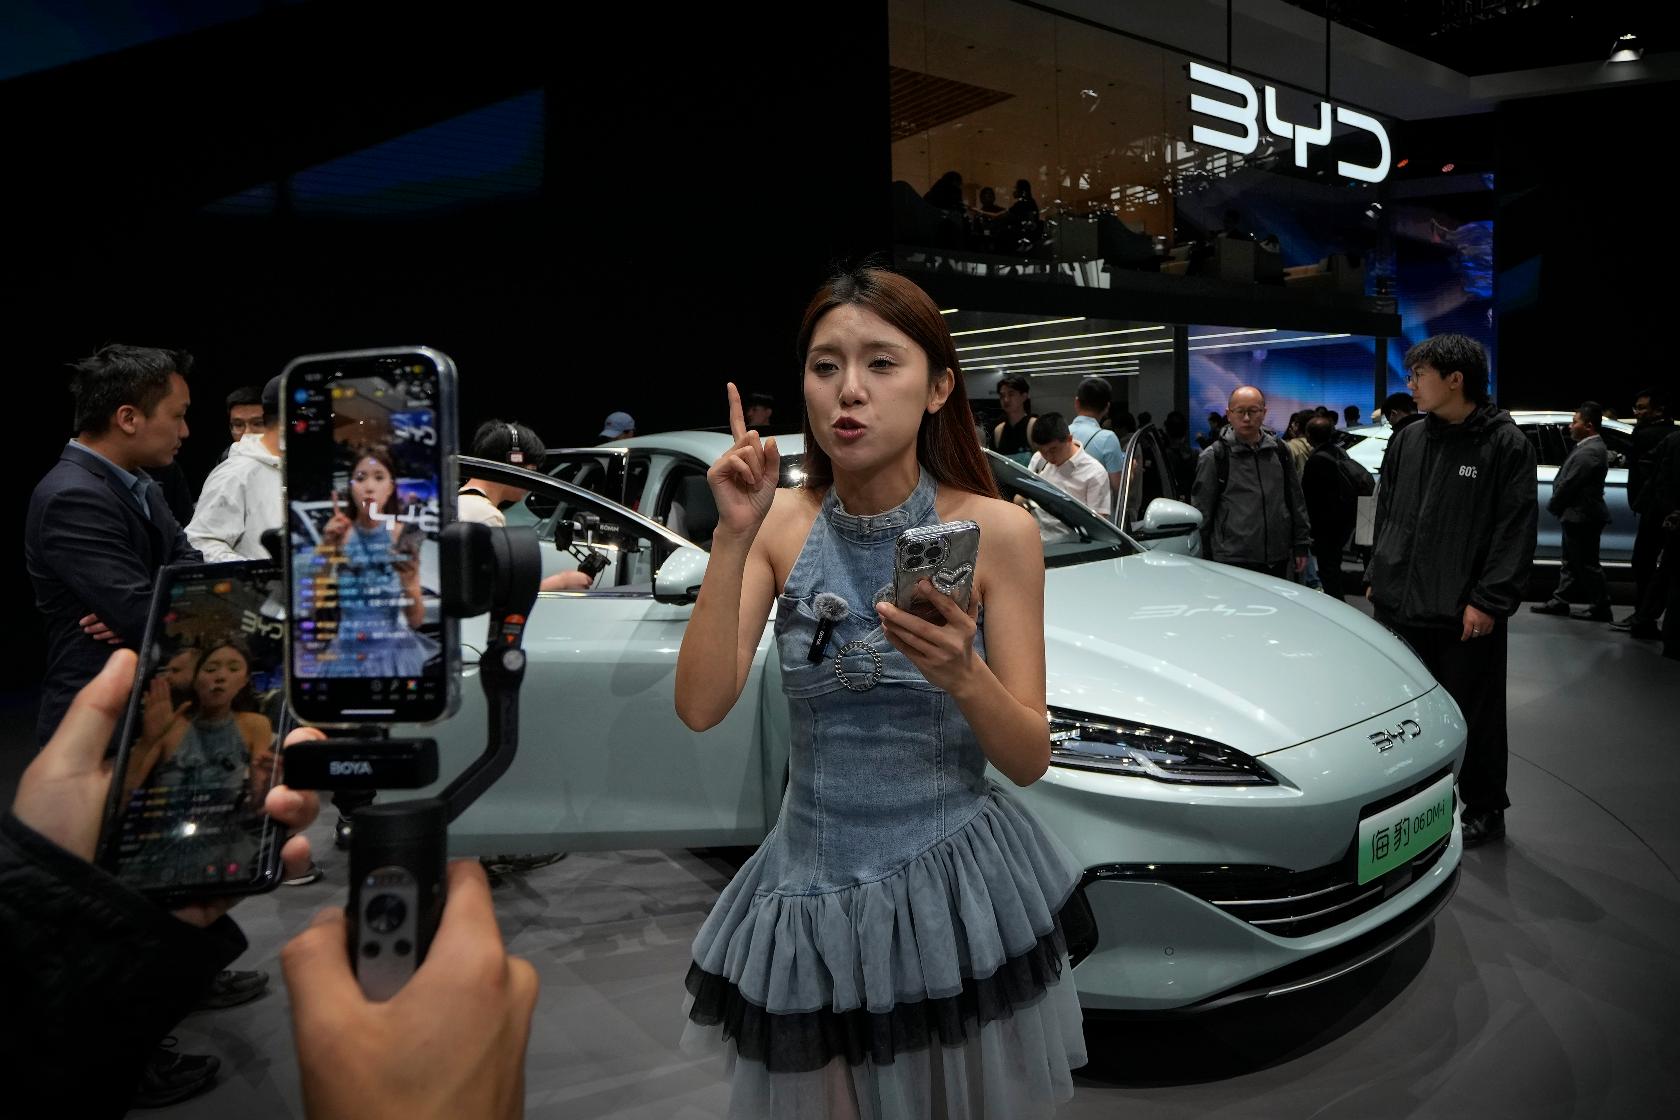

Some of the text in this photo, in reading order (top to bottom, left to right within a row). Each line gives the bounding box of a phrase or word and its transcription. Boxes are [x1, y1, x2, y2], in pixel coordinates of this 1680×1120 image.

[1189, 61, 1392, 184] BYD
[1366, 719, 1421, 753] BYD
[329, 760, 373, 775] BOYA
